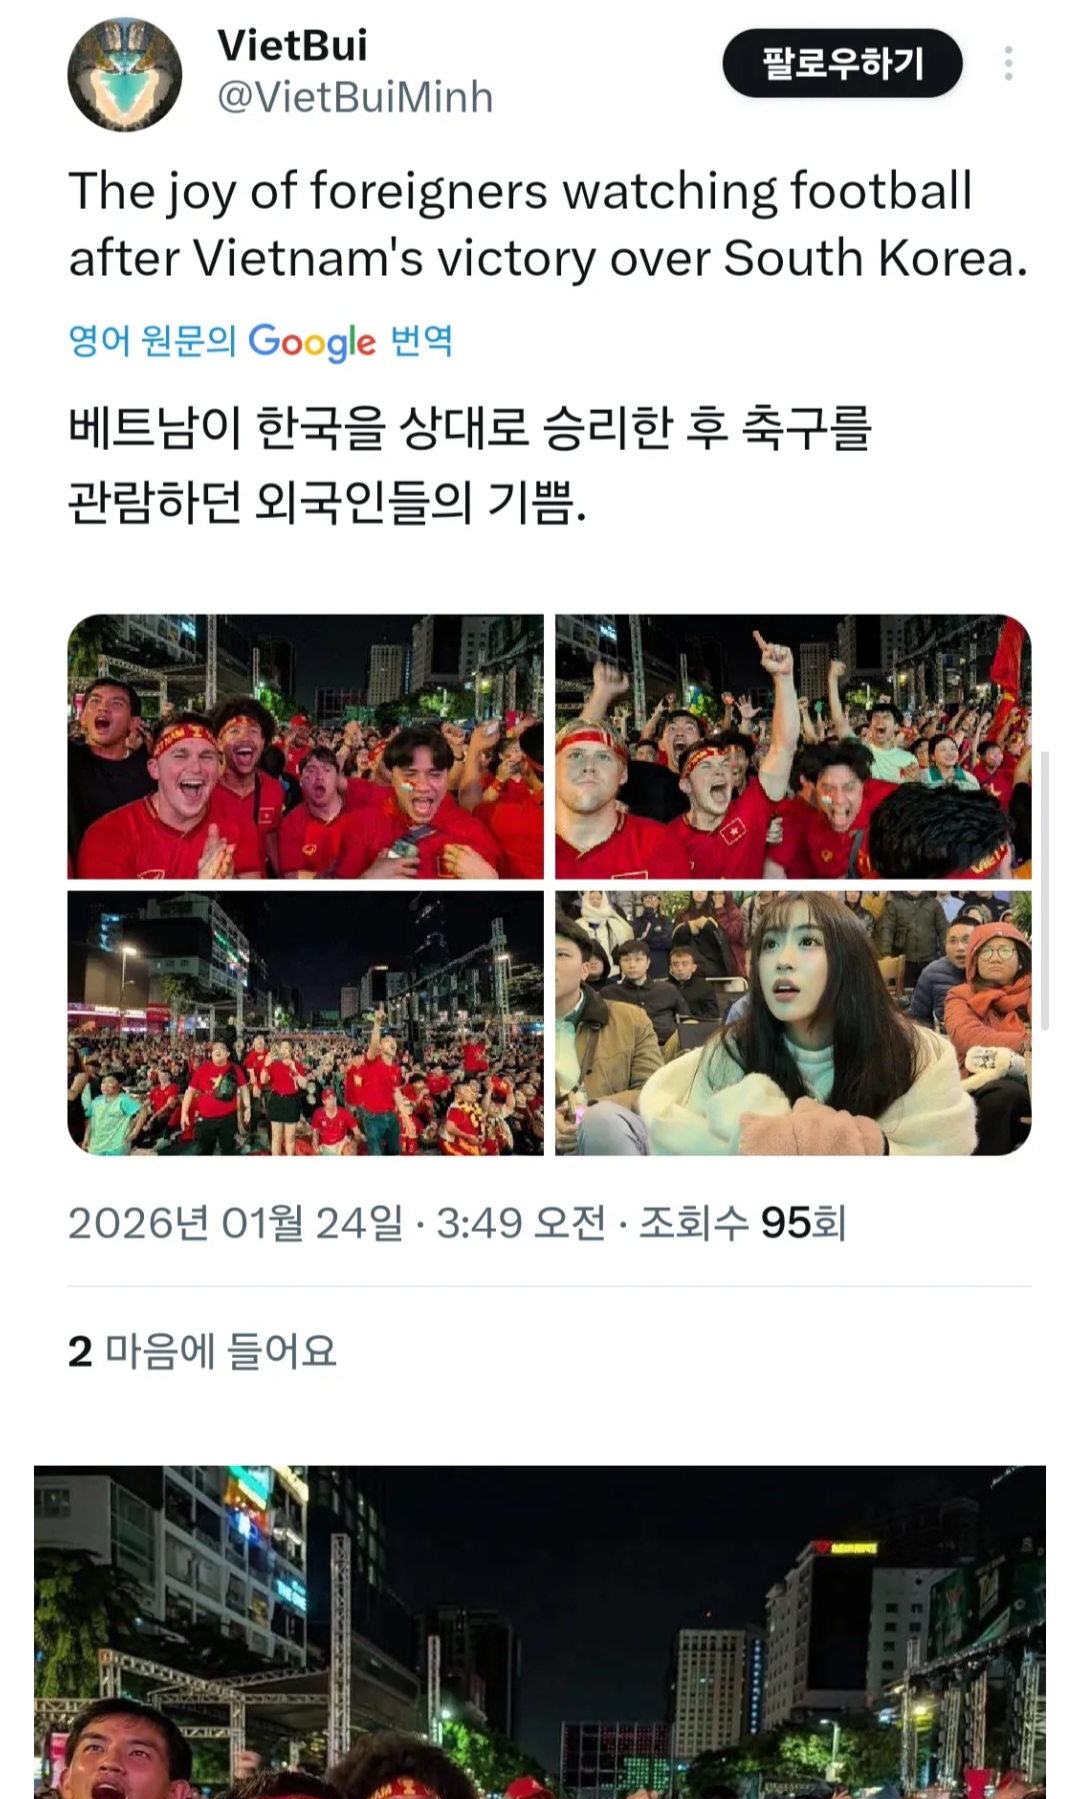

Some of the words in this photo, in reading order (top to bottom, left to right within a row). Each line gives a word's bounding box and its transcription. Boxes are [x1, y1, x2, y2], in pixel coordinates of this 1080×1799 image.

[217, 27, 366, 61] VietBui
[763, 47, 923, 80] 팔로우하기
[218, 79, 493, 114] @VietBuiMinh
[68, 169, 154, 209] The
[166, 169, 237, 220] joy
[252, 168, 297, 209] of
[310, 168, 548, 220] foreigners
[563, 169, 778, 220] watching
[790, 168, 971, 209] football
[69, 236, 180, 276] after
[193, 236, 422, 276] Vietnam's
[437, 236, 596, 287] victory
[611, 247, 711, 276] over
[725, 236, 862, 276] South
[881, 238, 1027, 276] Korea.
[69, 324, 130, 359] 영어
[141, 324, 236, 358] 원문의
[248, 323, 377, 365] Google
[391, 324, 452, 358] 번역
[69, 405, 240, 451] 베트남이
[256, 404, 387, 452] 한국을
[399, 405, 530, 450] 상대로
[543, 405, 674, 451] 승리한
[686, 405, 729, 451] 후
[742, 404, 873, 452] 축구를
[68, 479, 241, 526] 관람하던
[255, 479, 471, 527] 외국인들의
[488, 479, 586, 526] 기쁨.
[69, 1205, 208, 1242] 2026년
[222, 1205, 303, 1242] 01월
[316, 1205, 402, 1242] 24일
[437, 1206, 523, 1239] 3:49
[535, 1205, 605, 1242] 오전
[639, 1205, 750, 1242] 조회수
[761, 1205, 845, 1242] 95회
[69, 1334, 93, 1367] 2
[106, 1333, 214, 1371] 마음에
[227, 1333, 337, 1371] 들어요
